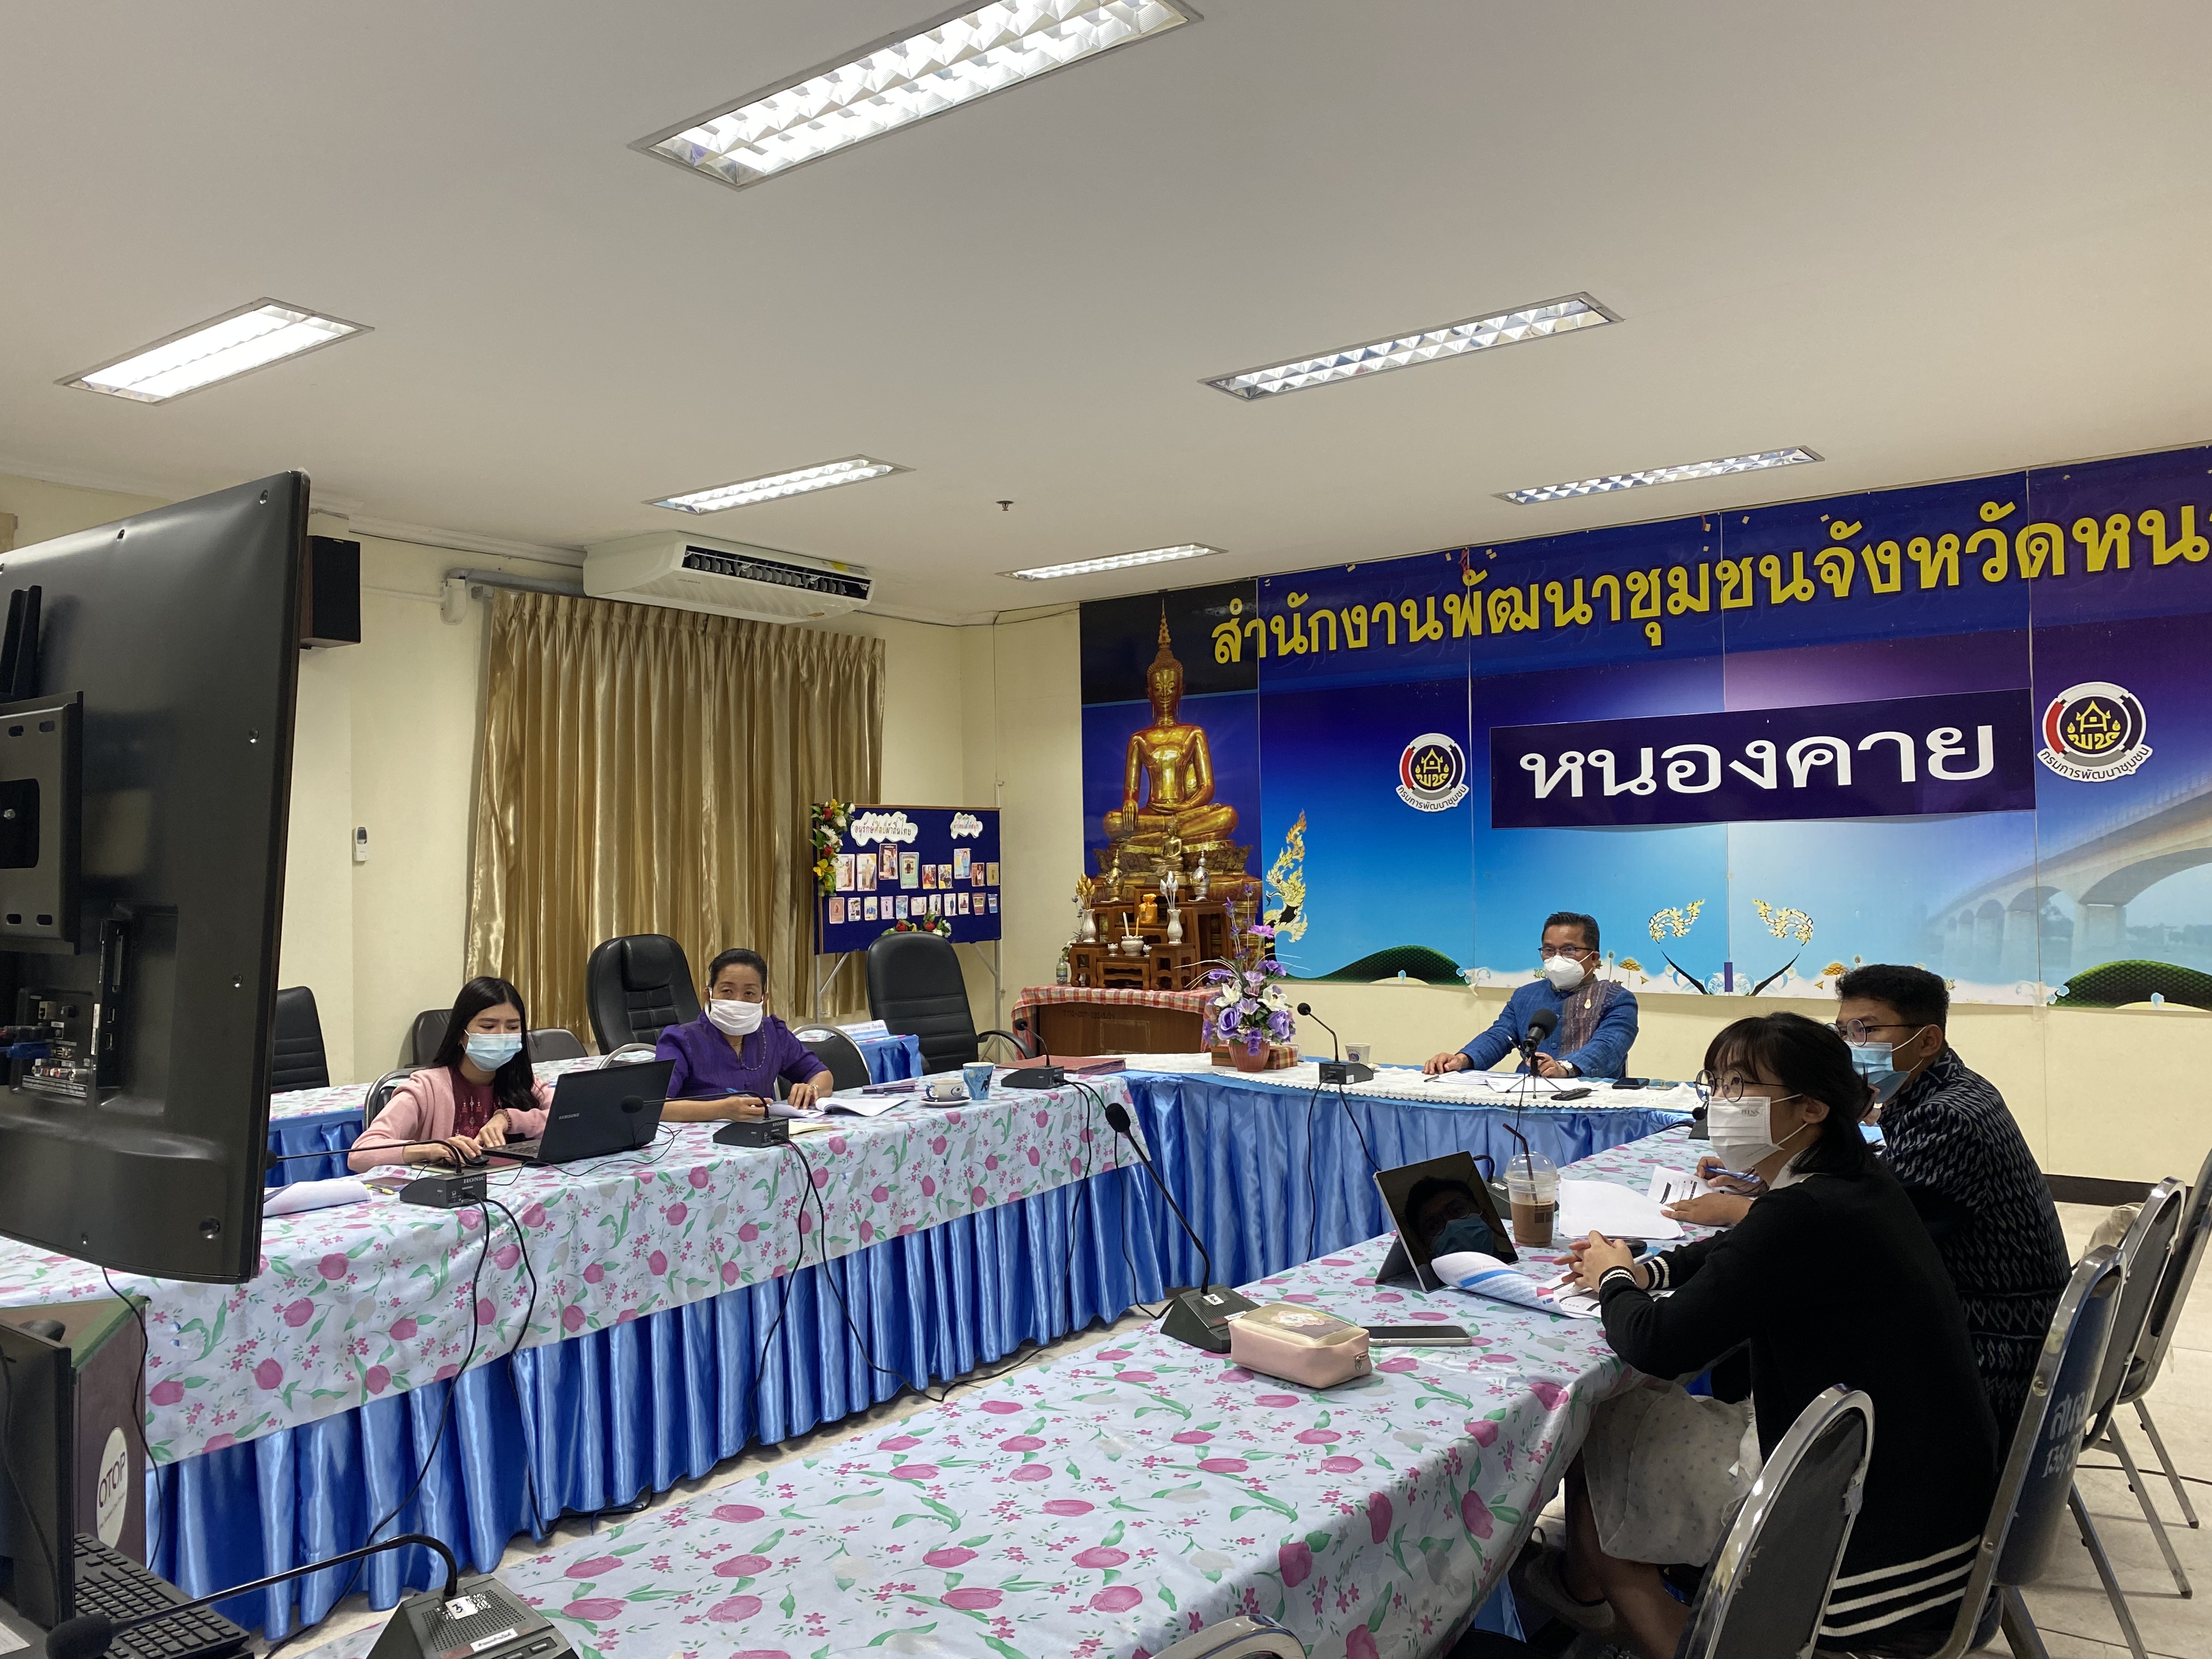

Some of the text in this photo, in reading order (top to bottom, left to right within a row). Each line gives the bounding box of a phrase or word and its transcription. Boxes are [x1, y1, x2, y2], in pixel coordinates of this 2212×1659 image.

[1211, 500, 2212, 664] สำนักงานพัฒนาชุมชนจังหวัดหน
[1520, 724, 1995, 799] หนองคาย
[2040, 747, 2149, 780] กรมการพัฒนาชุมชน
[1397, 786, 1467, 810] กรมการพัฒนาชุมชน
[463, 1176, 486, 1184] HONIC
[99, 1452, 125, 1508] OTOP
